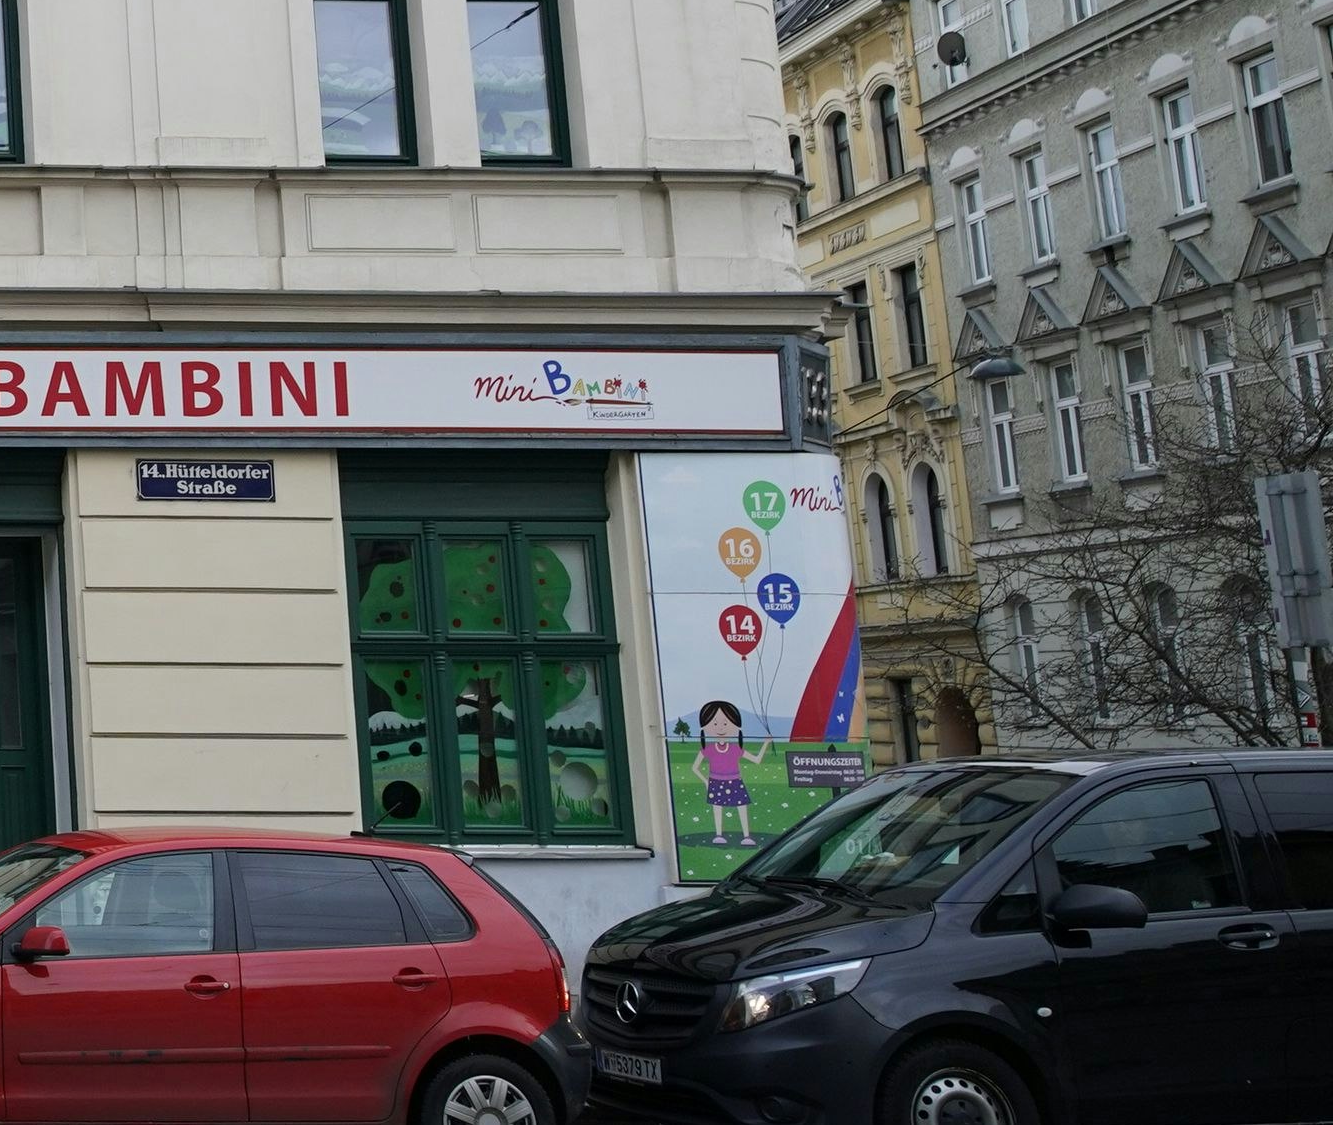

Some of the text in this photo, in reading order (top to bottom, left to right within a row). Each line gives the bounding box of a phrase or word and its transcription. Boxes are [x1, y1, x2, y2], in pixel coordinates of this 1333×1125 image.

[176, 480, 237, 495] Straße
[750, 492, 778, 511] 17
[750, 511, 781, 519] BEZIRK
[725, 538, 755, 558] 16
[725, 558, 756, 566] BEZIRK
[763, 583, 794, 604] 15
[764, 603, 795, 611] BEZIRK
[725, 615, 756, 635] 14
[726, 634, 757, 642] BEZIRK
